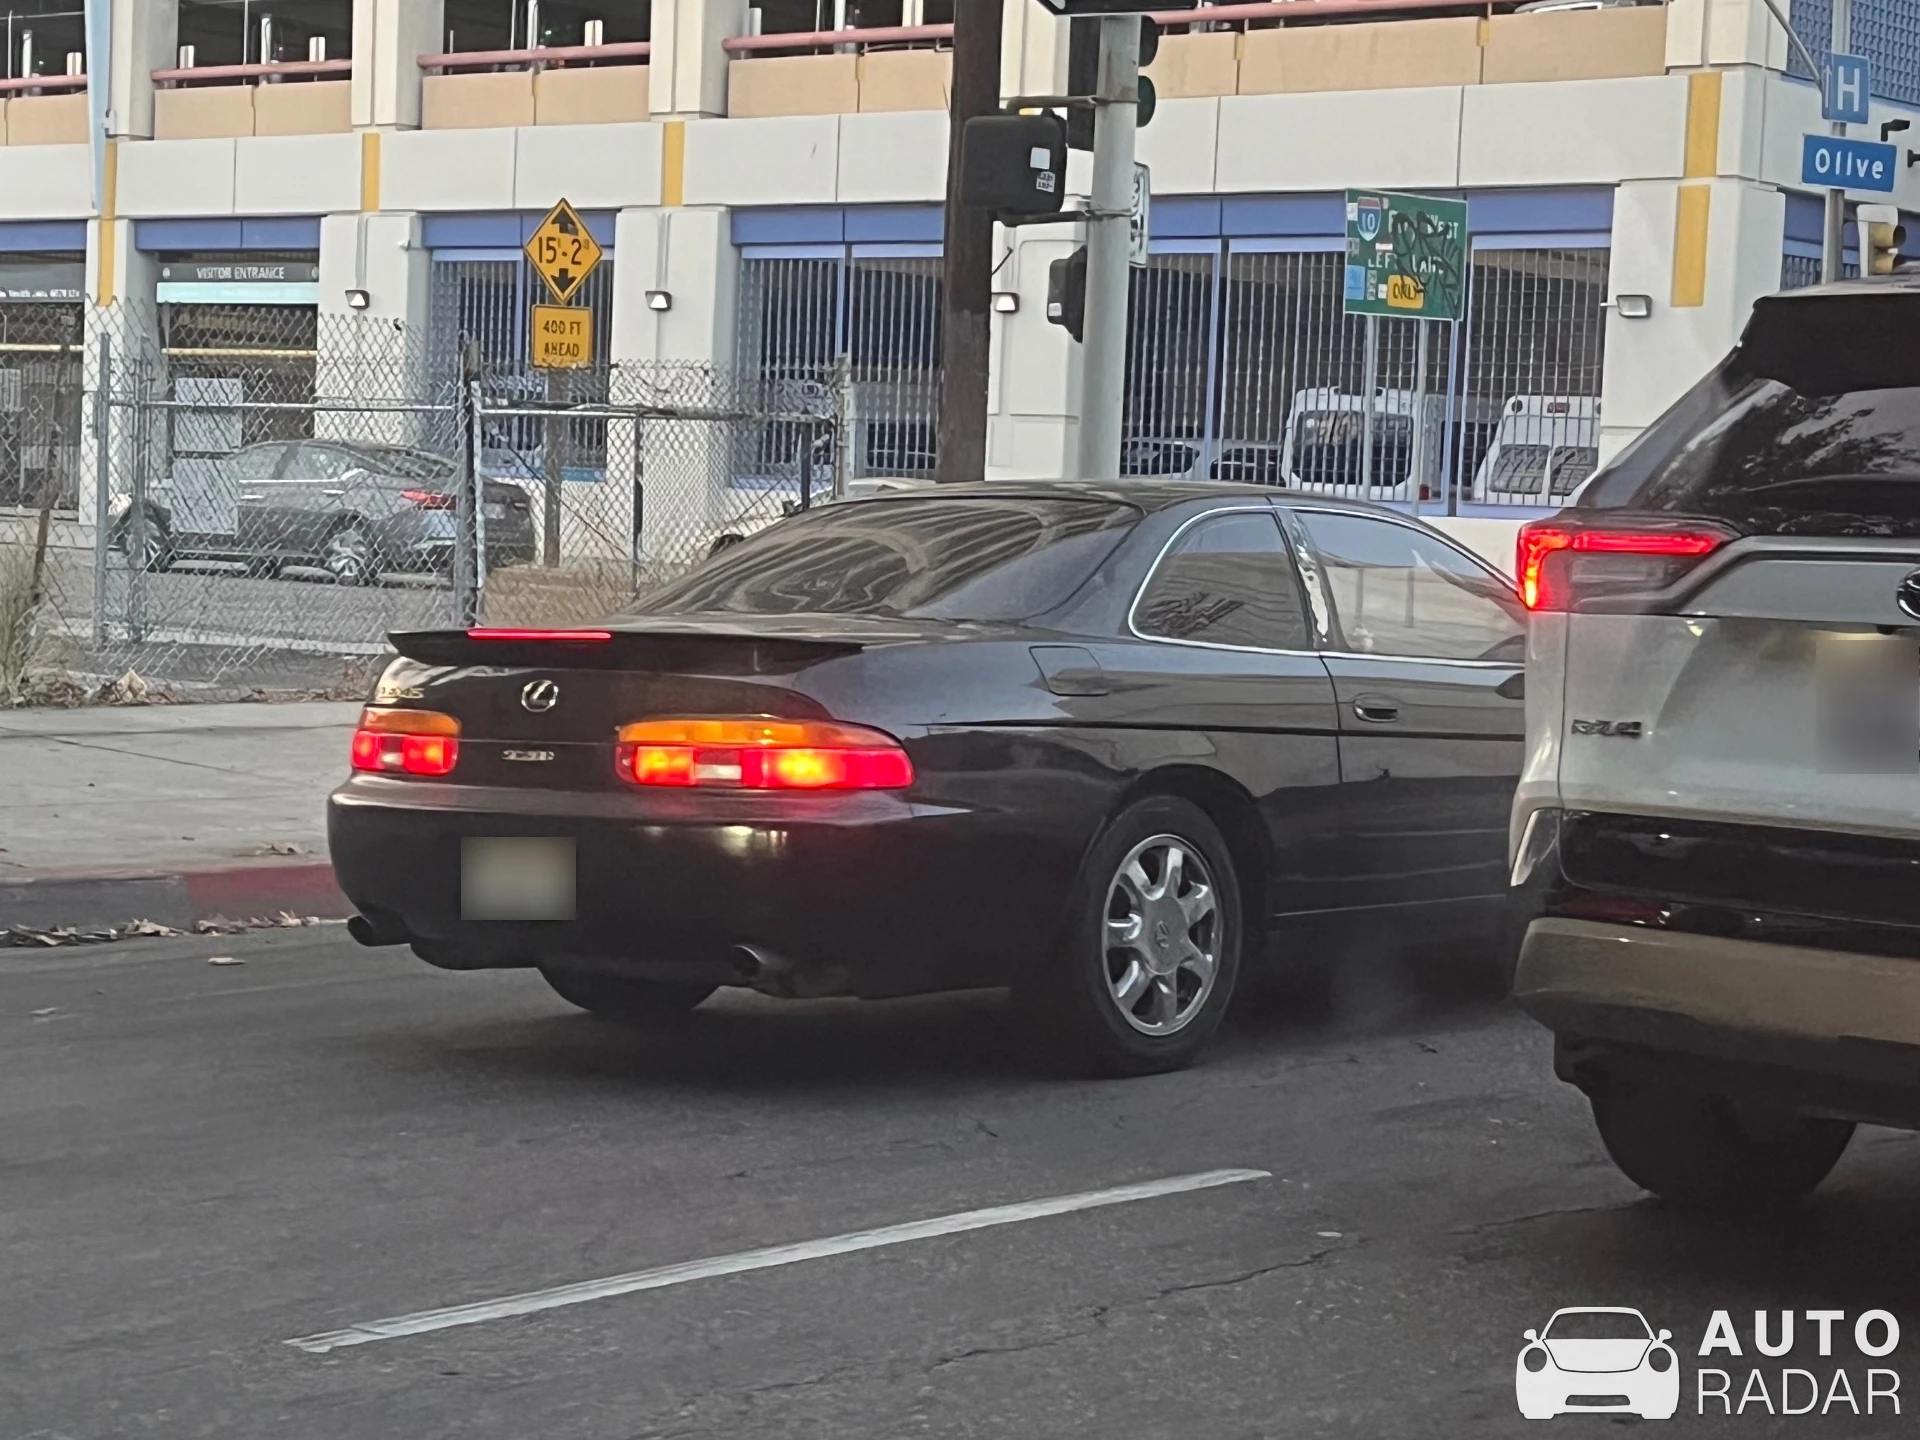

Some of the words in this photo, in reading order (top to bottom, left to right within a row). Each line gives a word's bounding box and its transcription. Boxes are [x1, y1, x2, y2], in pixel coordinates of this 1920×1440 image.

[1837, 65, 1860, 112] H
[1815, 148, 1884, 179] Olive
[1361, 213, 1376, 232] 10
[196, 266, 232, 279] VISITOR
[234, 266, 285, 279] ENTRANCE
[542, 319, 566, 335] 400
[570, 321, 582, 336] FT
[544, 342, 580, 358] AHEAD
